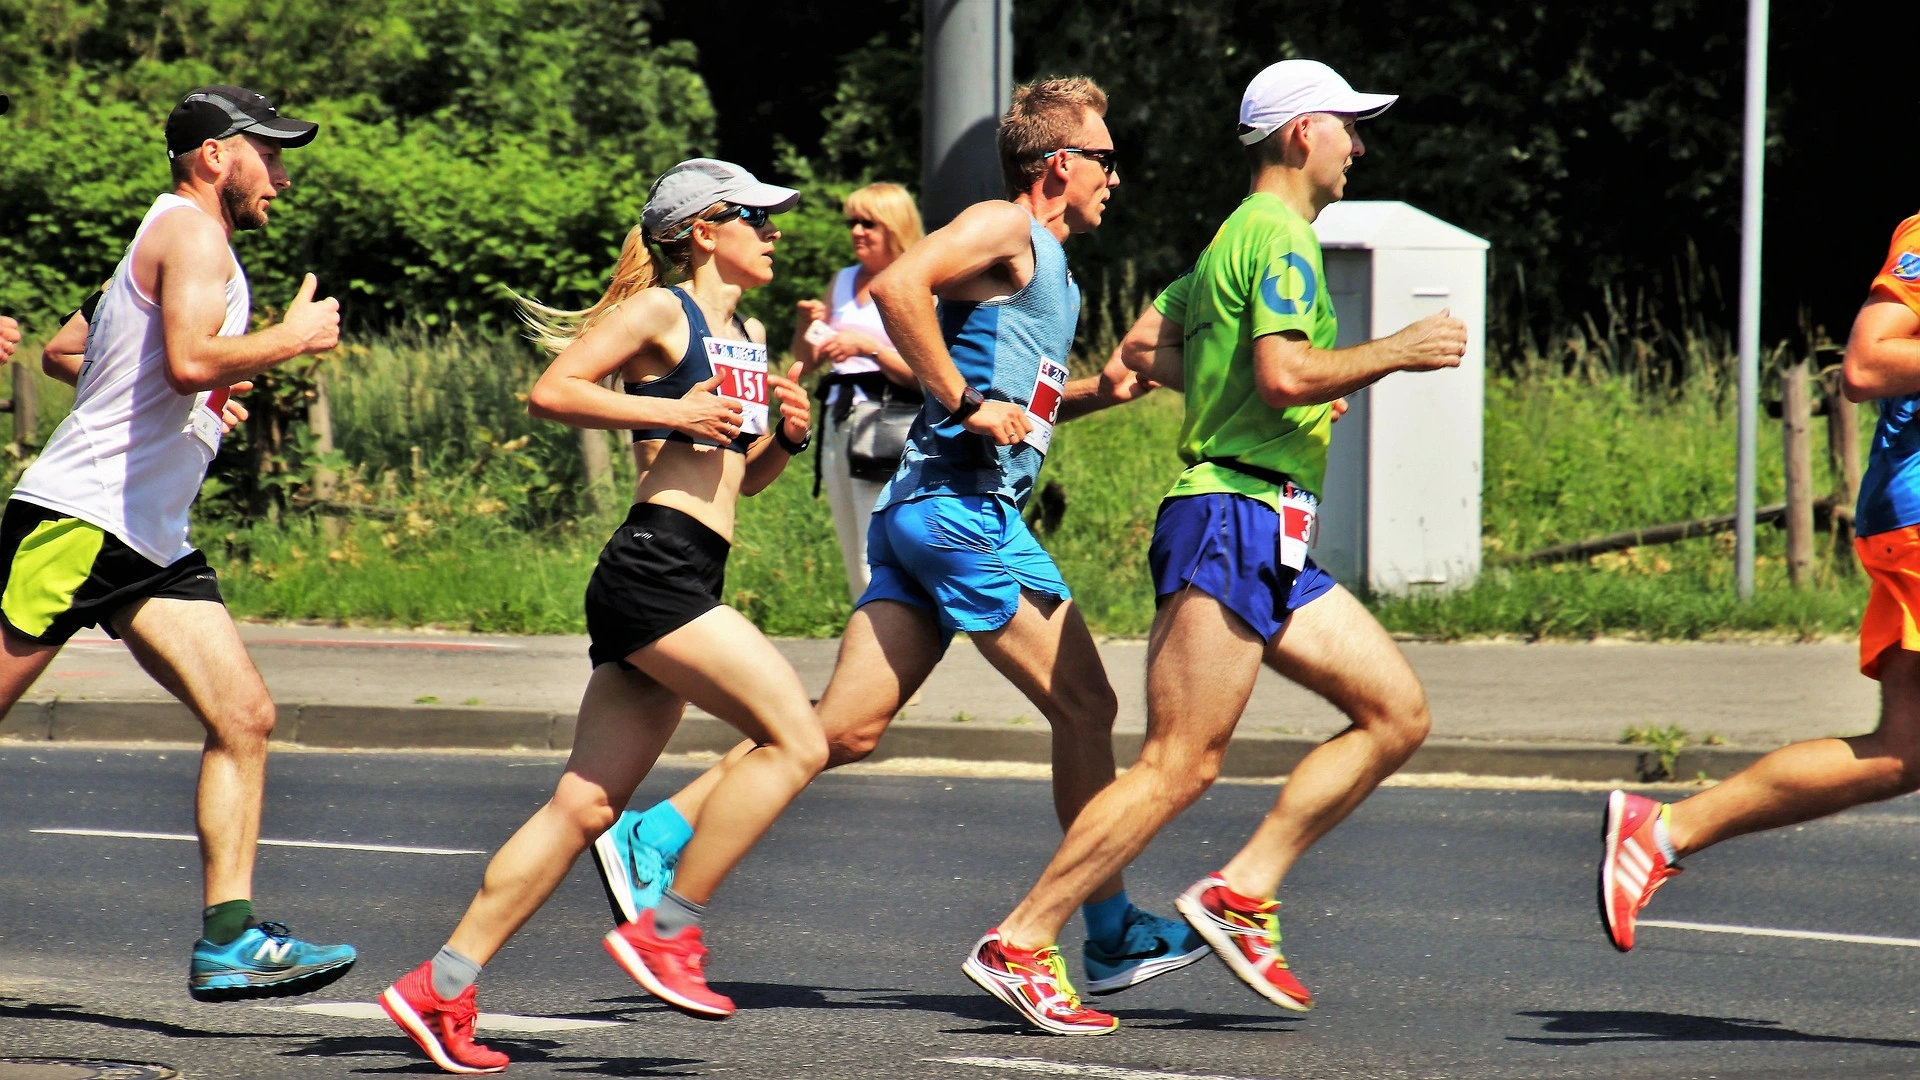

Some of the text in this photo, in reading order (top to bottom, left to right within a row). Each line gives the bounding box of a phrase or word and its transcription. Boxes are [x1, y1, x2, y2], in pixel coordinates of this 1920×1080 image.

[732, 368, 764, 402] 151
[1301, 514, 1312, 543] 3
[253, 938, 293, 964] N
